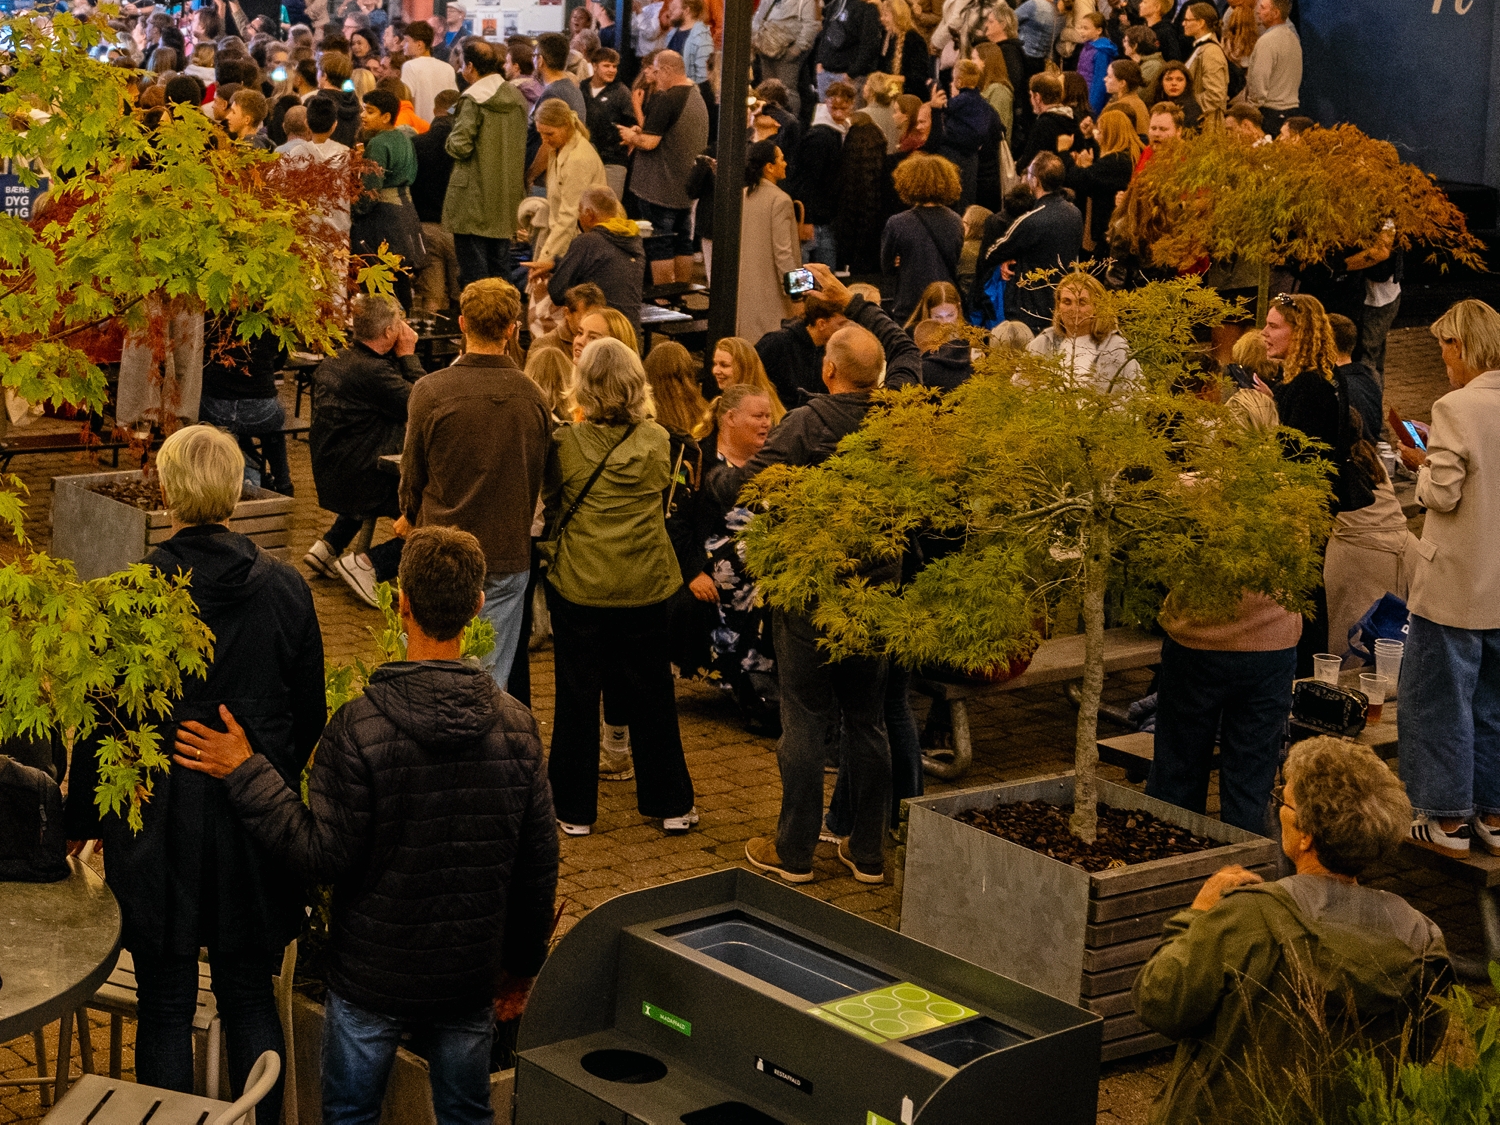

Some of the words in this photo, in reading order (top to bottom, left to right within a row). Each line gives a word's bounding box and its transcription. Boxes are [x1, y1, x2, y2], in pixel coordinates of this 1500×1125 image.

[5, 186, 29, 194] BÆRE
[5, 195, 29, 206] DYG
[5, 208, 29, 218] TIG
